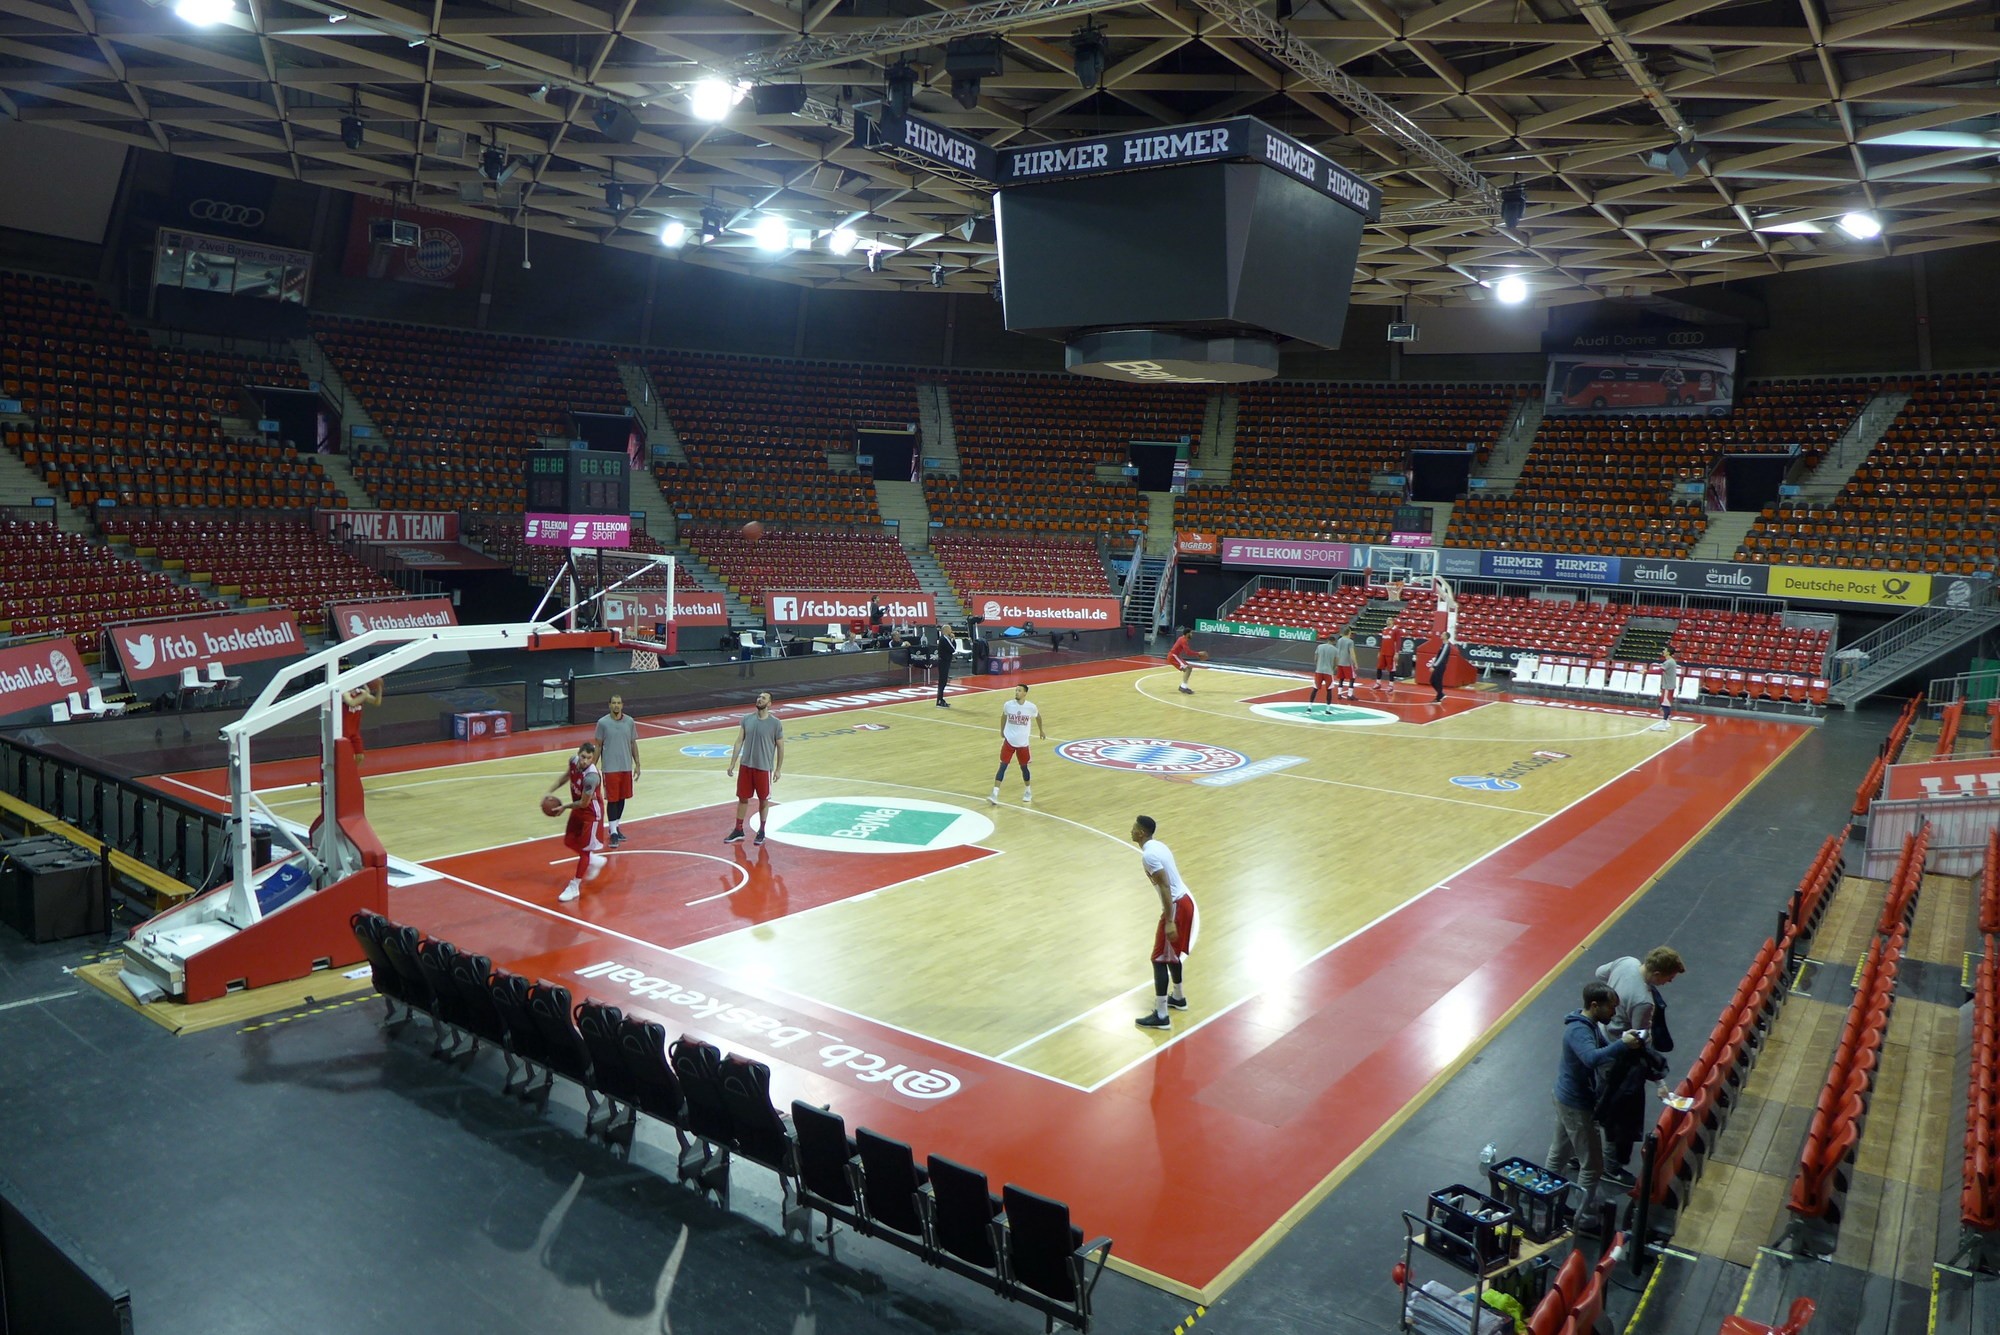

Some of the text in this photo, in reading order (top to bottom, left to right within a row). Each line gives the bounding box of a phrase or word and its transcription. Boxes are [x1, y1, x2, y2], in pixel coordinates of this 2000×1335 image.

[904, 119, 977, 170] HIRMER
[1012, 127, 1230, 177] HIRMER HIRMER
[1265, 133, 1371, 211] HIRMER HIRMER
[198, 240, 226, 251] Zwei
[269, 252, 285, 262] ein
[1573, 334, 1657, 347] Audi Dome
[341, 513, 383, 540] HAVE
[386, 514, 399, 540] A
[402, 514, 445, 540] TEAM
[541, 520, 568, 531] TELEKOM
[592, 521, 628, 532] TELEKOM
[541, 530, 560, 539] SPORT
[592, 531, 617, 540] SPORT
[1180, 541, 1213, 551] BIGREDS
[1244, 546, 1345, 562] TELEKOM SPORT
[1445, 565, 1473, 573] München
[1446, 558, 1476, 566] Flughafen
[1493, 556, 1543, 568] HIRMER
[1555, 559, 1608, 572] HIRMER
[1634, 564, 1678, 581] emilo
[1706, 568, 1752, 585] emilo
[1785, 577, 1877, 595] Deutsche Post
[369, 611, 451, 631] fcbbasketball
[1003, 606, 1108, 620] fcb-basketball.de
[1200, 621, 1311, 640] BayWa BayWa BayWa
[160, 621, 296, 663] /fcb_basketball
[1469, 646, 1503, 659] adidas
[1510, 652, 1539, 660] adida
[677, 714, 731, 726] Audi
[783, 682, 968, 712] MUNICH
[1069, 739, 1173, 752] BAYERN
[1135, 748, 1237, 771] MÜNCHEN
[574, 960, 962, 1099] @fcb_basketball
